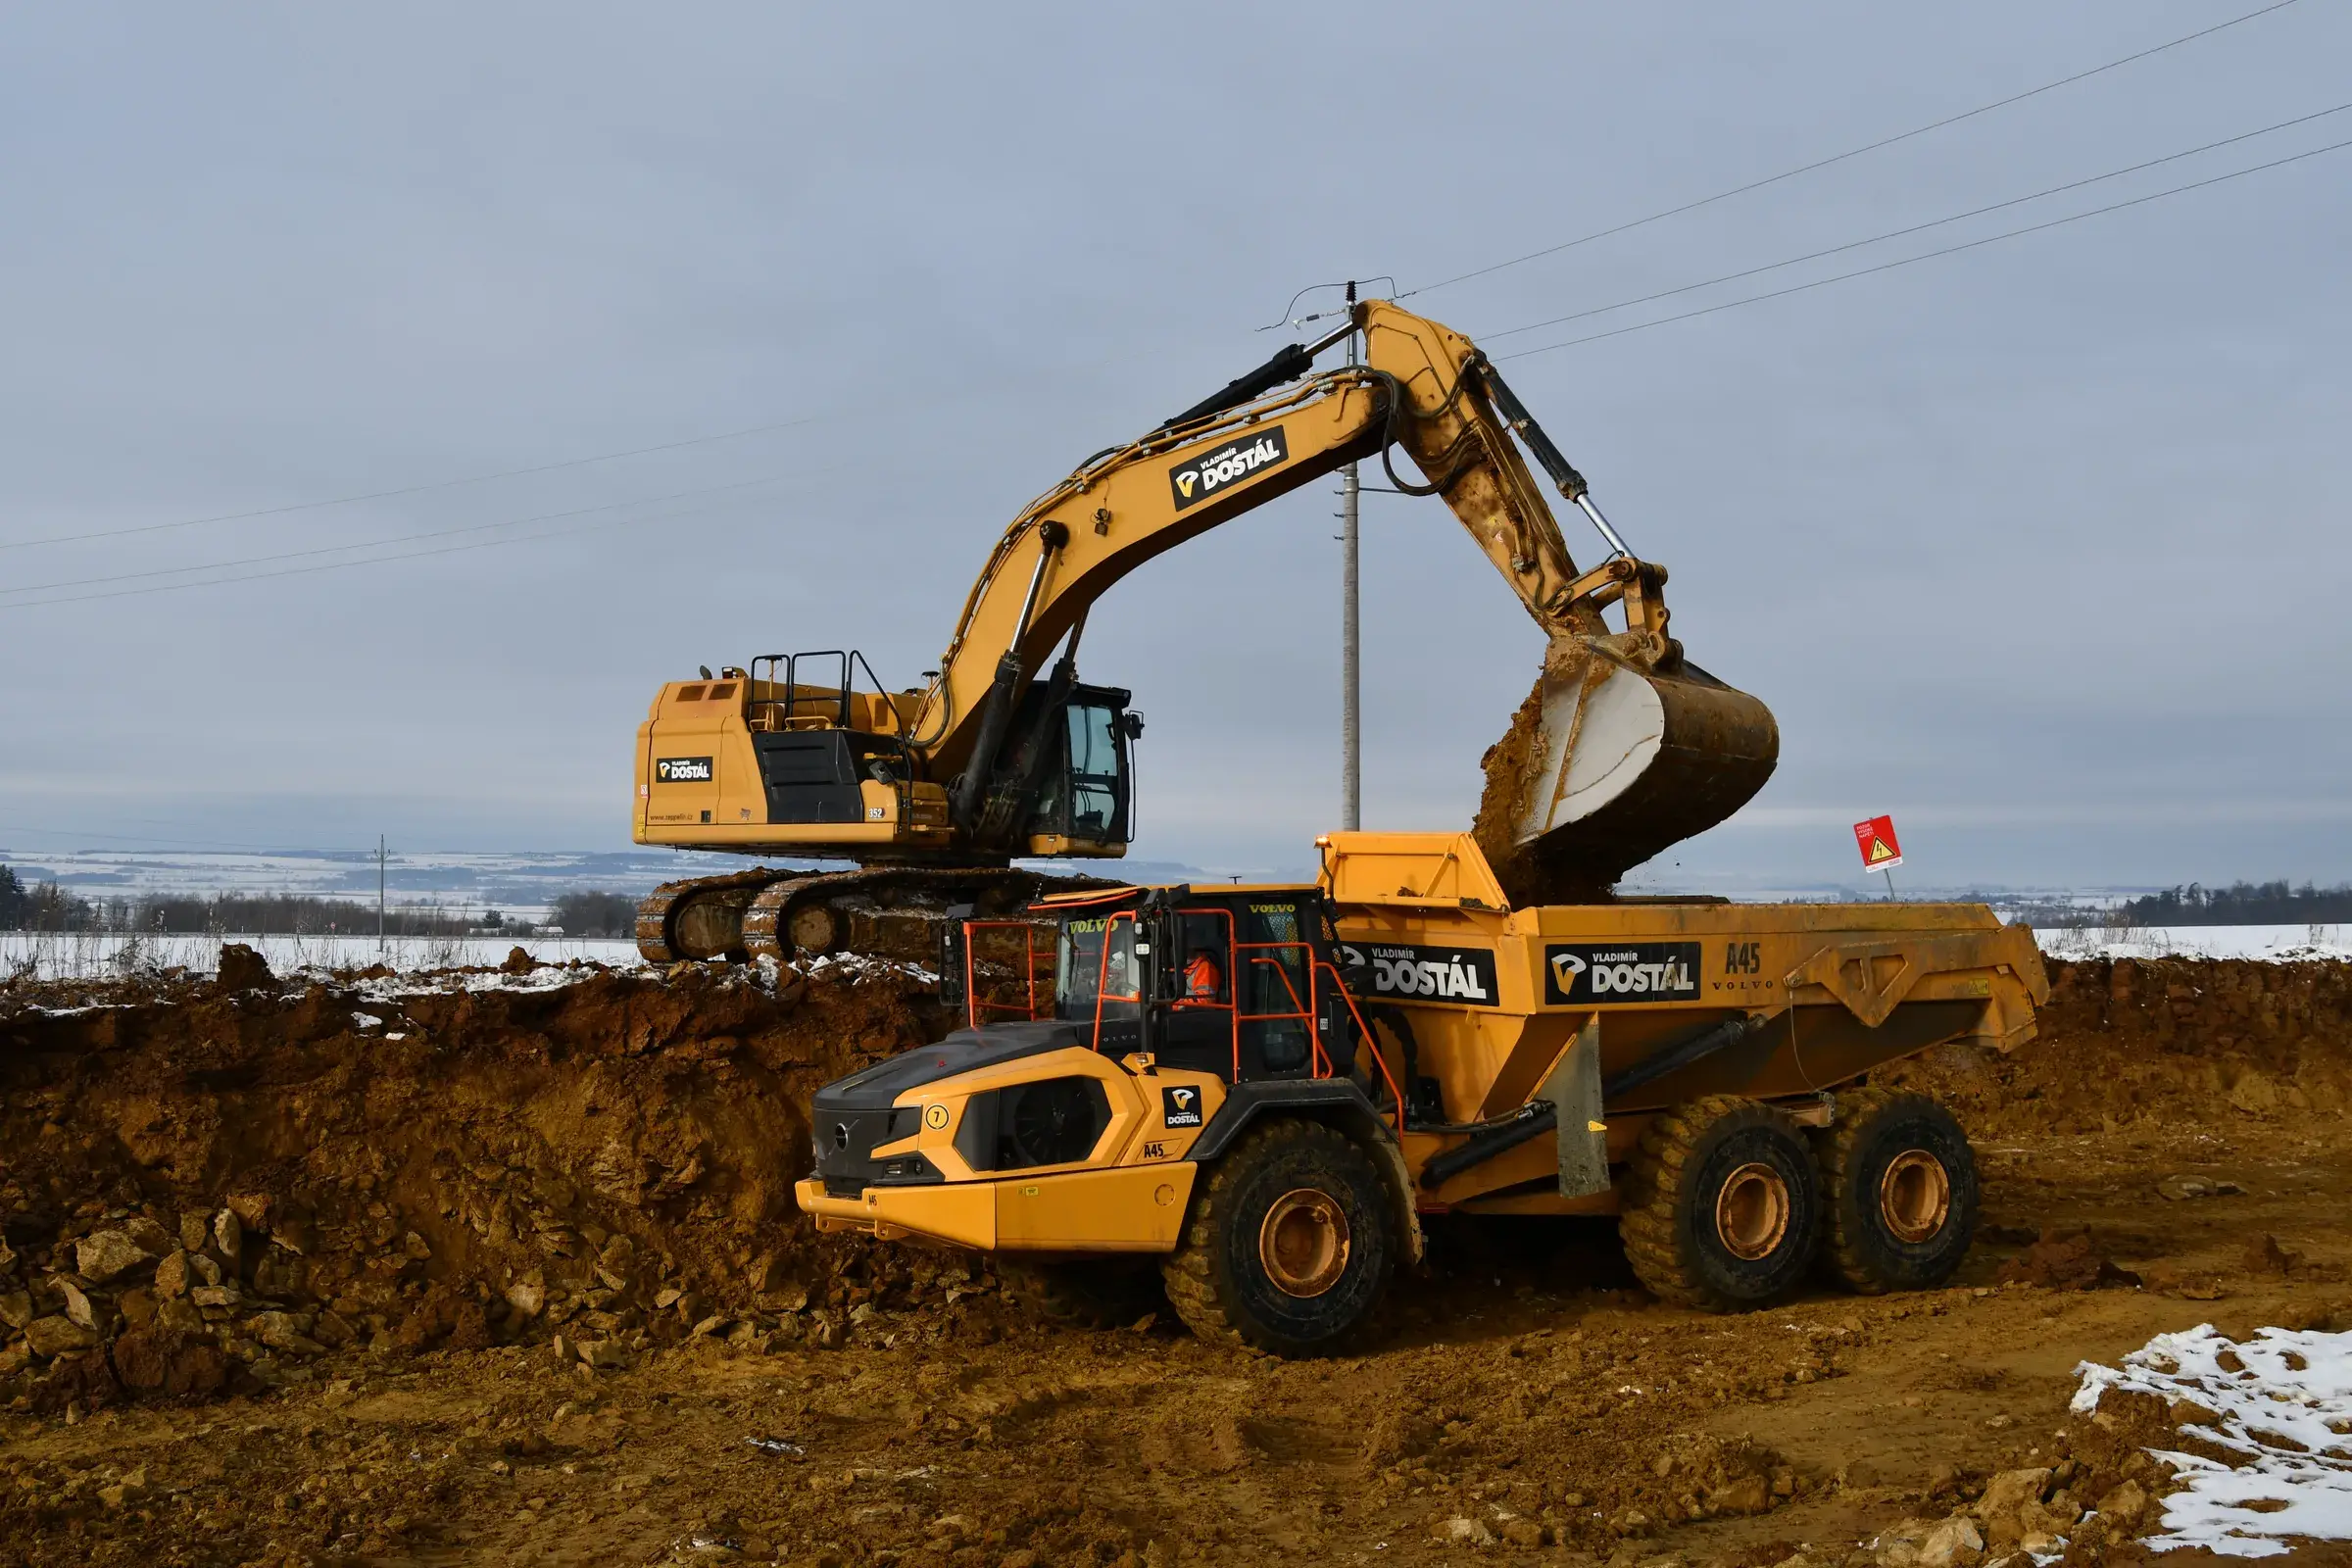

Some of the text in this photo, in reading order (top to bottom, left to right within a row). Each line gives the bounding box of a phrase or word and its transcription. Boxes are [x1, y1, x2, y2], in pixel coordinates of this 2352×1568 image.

[1200, 447, 1238, 470] VLADIMÍR
[1201, 438, 1280, 491] DOSTÁL
[671, 762, 710, 779] DOSTÁL
[868, 808, 883, 818] 352
[1249, 904, 1296, 913] VOLVO
[1371, 948, 1415, 960] VLADIMÍR
[1592, 950, 1639, 962] VLADIMÍR
[1725, 942, 1761, 974] A45
[1372, 955, 1487, 1000] DOSTÁL
[1592, 955, 1694, 994] DOSTÁL
[1712, 980, 1774, 990] VOLVO
[933, 1110, 941, 1123] 7
[1167, 1112, 1200, 1125] DOSTÁL
[1144, 1143, 1164, 1158] A45
[868, 1194, 877, 1206] A45
